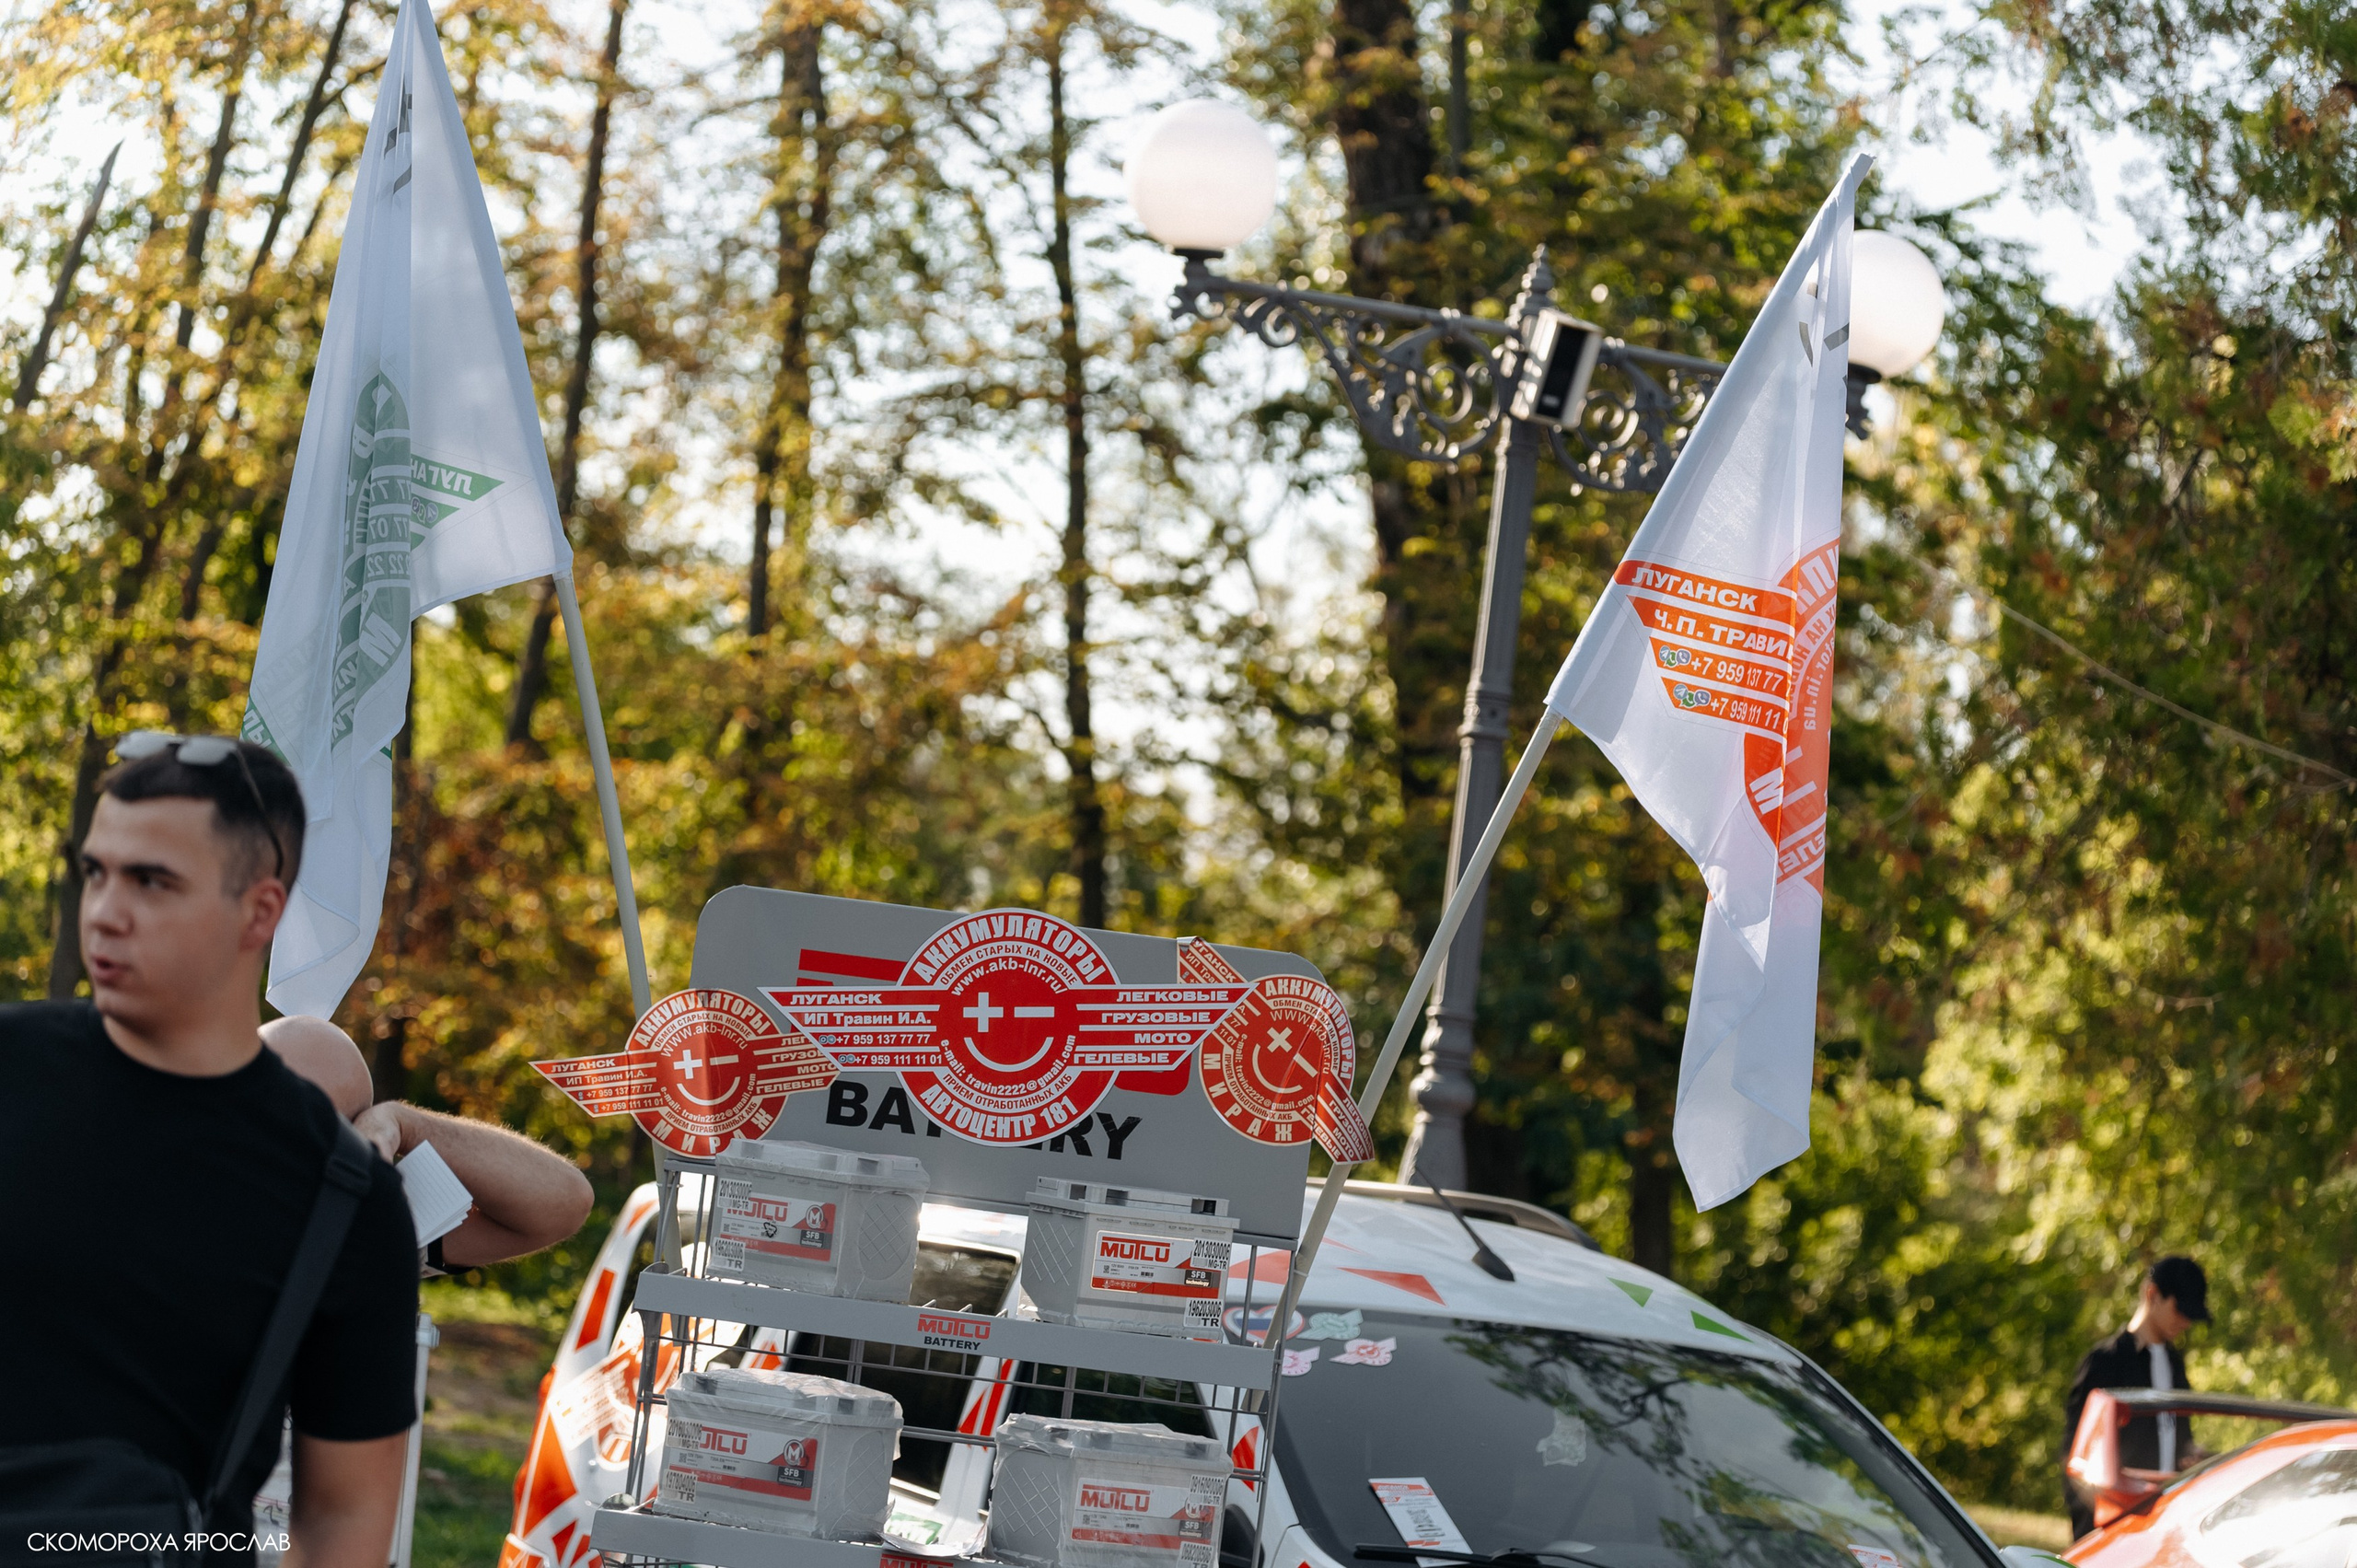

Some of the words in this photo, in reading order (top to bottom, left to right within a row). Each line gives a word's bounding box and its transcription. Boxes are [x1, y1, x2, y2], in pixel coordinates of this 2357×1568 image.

[1632, 566, 1759, 612] ЛУГАНСК
[1690, 657, 1713, 676] +7
[1716, 660, 1745, 683] 959
[1747, 667, 1761, 688] 137
[1764, 670, 1784, 691] 77
[1711, 698, 1729, 715] +7
[1729, 701, 1748, 721] 959
[1748, 705, 1762, 725] 111
[1765, 709, 1782, 729] 11
[913, 915, 1107, 983] АККУМУЛЯТОРЫ
[940, 953, 974, 986] ОБМЕН
[977, 945, 1022, 959] СТАРЫХ
[1026, 947, 1040, 959] НА
[1043, 955, 1078, 986] НОВЫЕ
[1185, 952, 1202, 969] ИП
[1192, 940, 1237, 983] УГАНСК
[790, 993, 882, 1005] ЛУГАНСК
[1116, 991, 1229, 1003] ЛЕГКОВЫЕ
[1272, 1000, 1303, 1008] ОБМЕН
[634, 992, 772, 1049] АККУМУЛЯТОРЫ
[804, 1013, 829, 1025] ИП
[832, 1013, 893, 1028] Травин
[899, 1013, 932, 1024] И.А.
[1101, 1012, 1212, 1024] ГРУЗОВЫЕ
[1230, 1016, 1242, 1029] 77
[655, 1025, 677, 1048] ОБМЕН
[677, 1013, 711, 1027] СТАРЫХ
[713, 1014, 725, 1022] НА
[725, 1016, 753, 1039] НОВЫЕ
[1265, 979, 1353, 1080] АККУМУЛЯТОРЫ
[660, 1022, 749, 1059] www.akb-lnr.ru
[836, 1035, 851, 1045] +7
[853, 1034, 874, 1045] 959
[877, 1034, 896, 1045] 137
[898, 1034, 915, 1044] 77
[917, 1034, 931, 1044] 77
[1134, 1032, 1191, 1044] МОТО
[1226, 1036, 1237, 1046] 01
[551, 1059, 616, 1073] ЛУГАНСК
[854, 1055, 868, 1065] +7
[870, 1055, 890, 1065] 959
[894, 1055, 911, 1065] 111
[914, 1055, 927, 1065] 11
[929, 1055, 943, 1064] 01
[940, 1039, 967, 1077] e-mail:
[965, 1034, 1076, 1096] travin2222@gmail.com
[1074, 1052, 1169, 1064] ГЕЛЕВЫЕ
[796, 1063, 837, 1075] МОТО
[566, 1076, 583, 1086] ИП
[585, 1073, 624, 1085] Травин
[625, 1069, 648, 1079] И.А.
[586, 1090, 597, 1098] +7
[598, 1088, 613, 1098] 959
[615, 1086, 629, 1096] 137
[631, 1085, 643, 1094] 77
[643, 1084, 654, 1093] 77
[756, 1078, 825, 1095] ГЕЛЕВЫЕ
[943, 1074, 973, 1101] ПРИЕМ
[975, 1086, 1055, 1110] ОТРАБОТАННЫХ
[1053, 1073, 1073, 1093] АКБ
[1235, 1065, 1316, 1110] travin2222@gmail.com
[601, 1103, 610, 1111] +7
[612, 1101, 627, 1111] 959
[629, 1099, 642, 1109] 111
[644, 1098, 653, 1108] 11
[654, 1098, 664, 1106] 01
[681, 1074, 757, 1123] travin2222@gmail.com
[920, 1084, 1037, 1139] АВТОЦЕНТР
[1039, 1095, 1079, 1129] 181
[666, 1110, 690, 1130] ПРИЕМ
[690, 1112, 748, 1133] ОТРАБОТАННЫХ
[1332, 1127, 1354, 1158] МОТО
[806, 1231, 819, 1239] SFB
[1100, 1237, 1170, 1262] MUTLU
[727, 1259, 742, 1269] TR
[1208, 1259, 1227, 1270] MG-TR
[1190, 1271, 1206, 1279] SFB
[917, 1314, 992, 1340] MUTLU
[1202, 1318, 1219, 1327] TR
[923, 1336, 981, 1351] BATTERY
[700, 1426, 748, 1455] UTLU
[784, 1468, 799, 1477] SFB
[679, 1491, 695, 1502] TR
[1080, 1484, 1152, 1513] MUTLU
[1184, 1521, 1200, 1529] SFB
